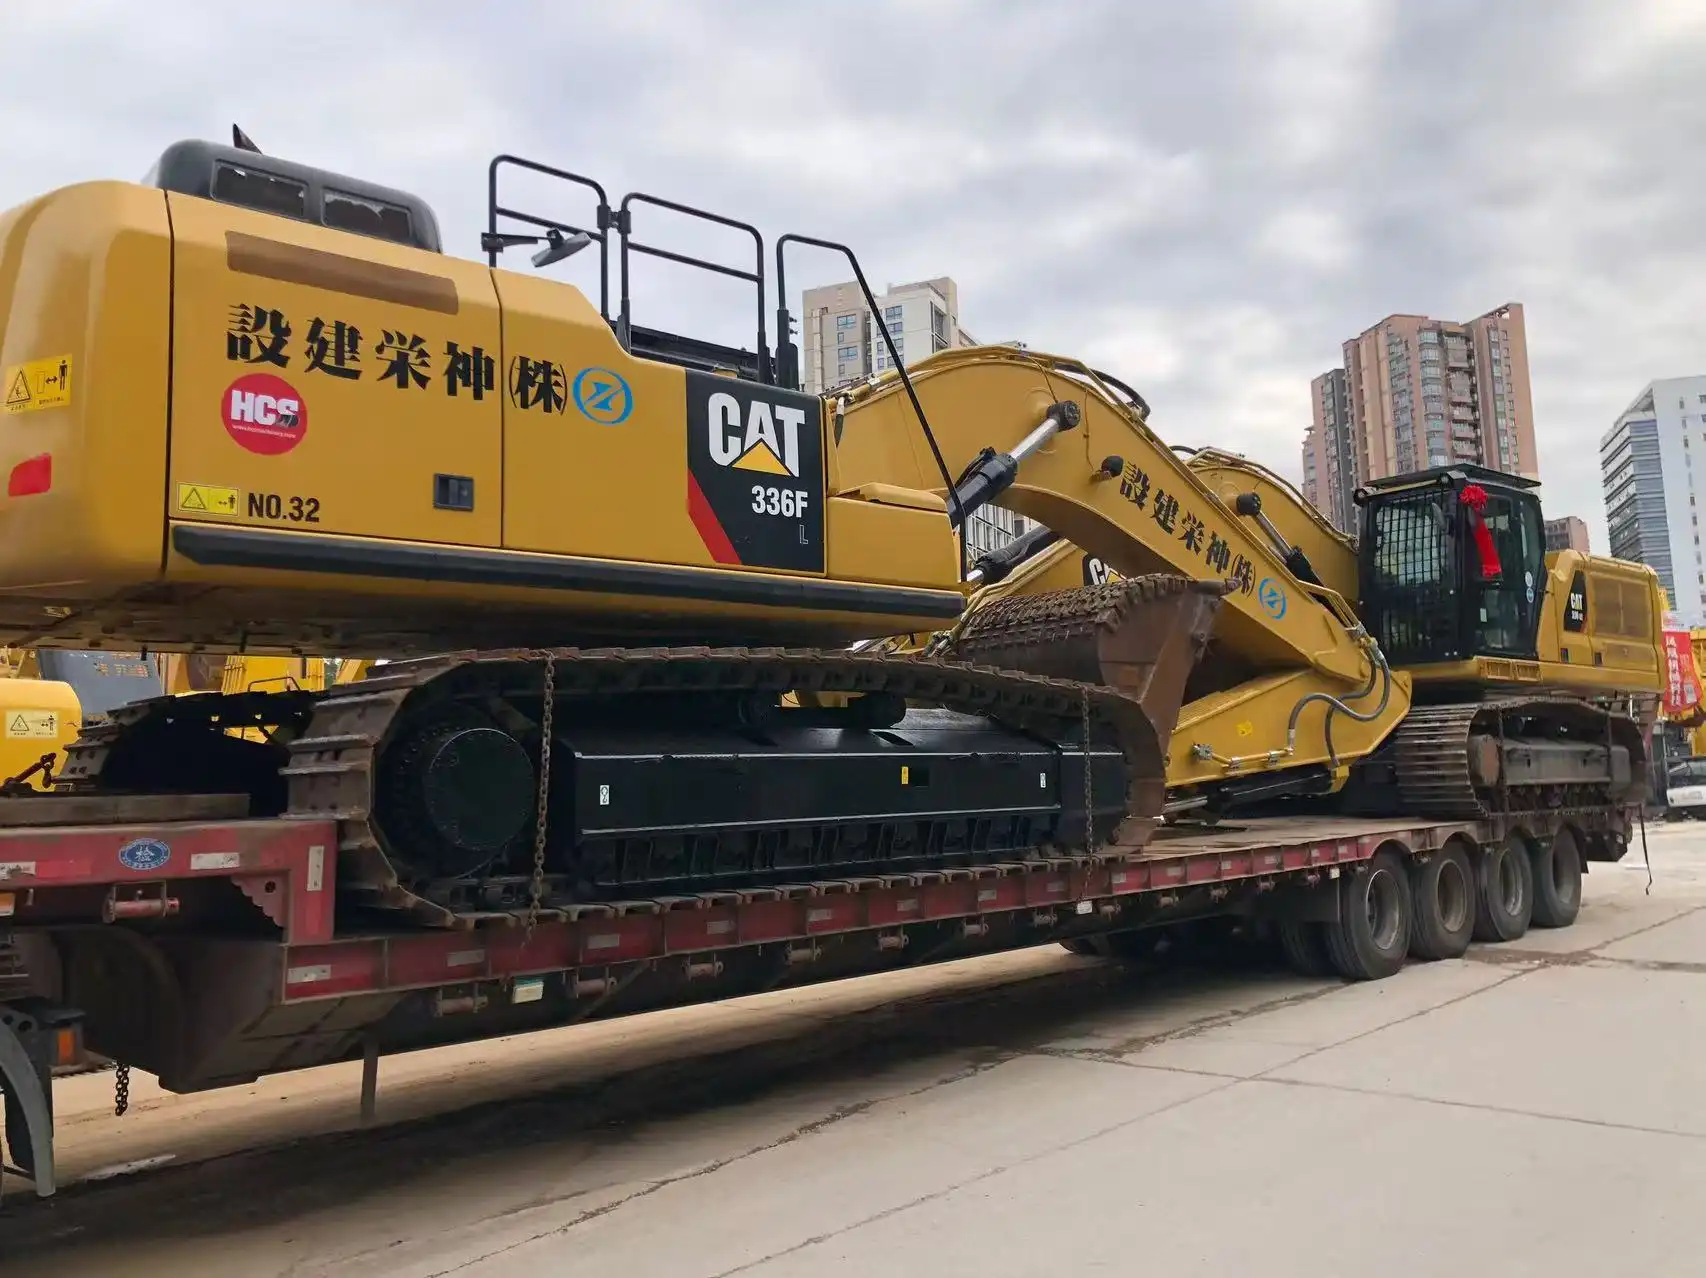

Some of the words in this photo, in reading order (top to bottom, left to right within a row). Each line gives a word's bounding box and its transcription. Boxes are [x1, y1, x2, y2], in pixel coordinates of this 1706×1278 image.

[708, 392, 806, 478] CAT
[248, 492, 320, 523] NO.32
[751, 485, 808, 518] 336F
[799, 524, 809, 545] L
[1570, 592, 1583, 611] CAT
